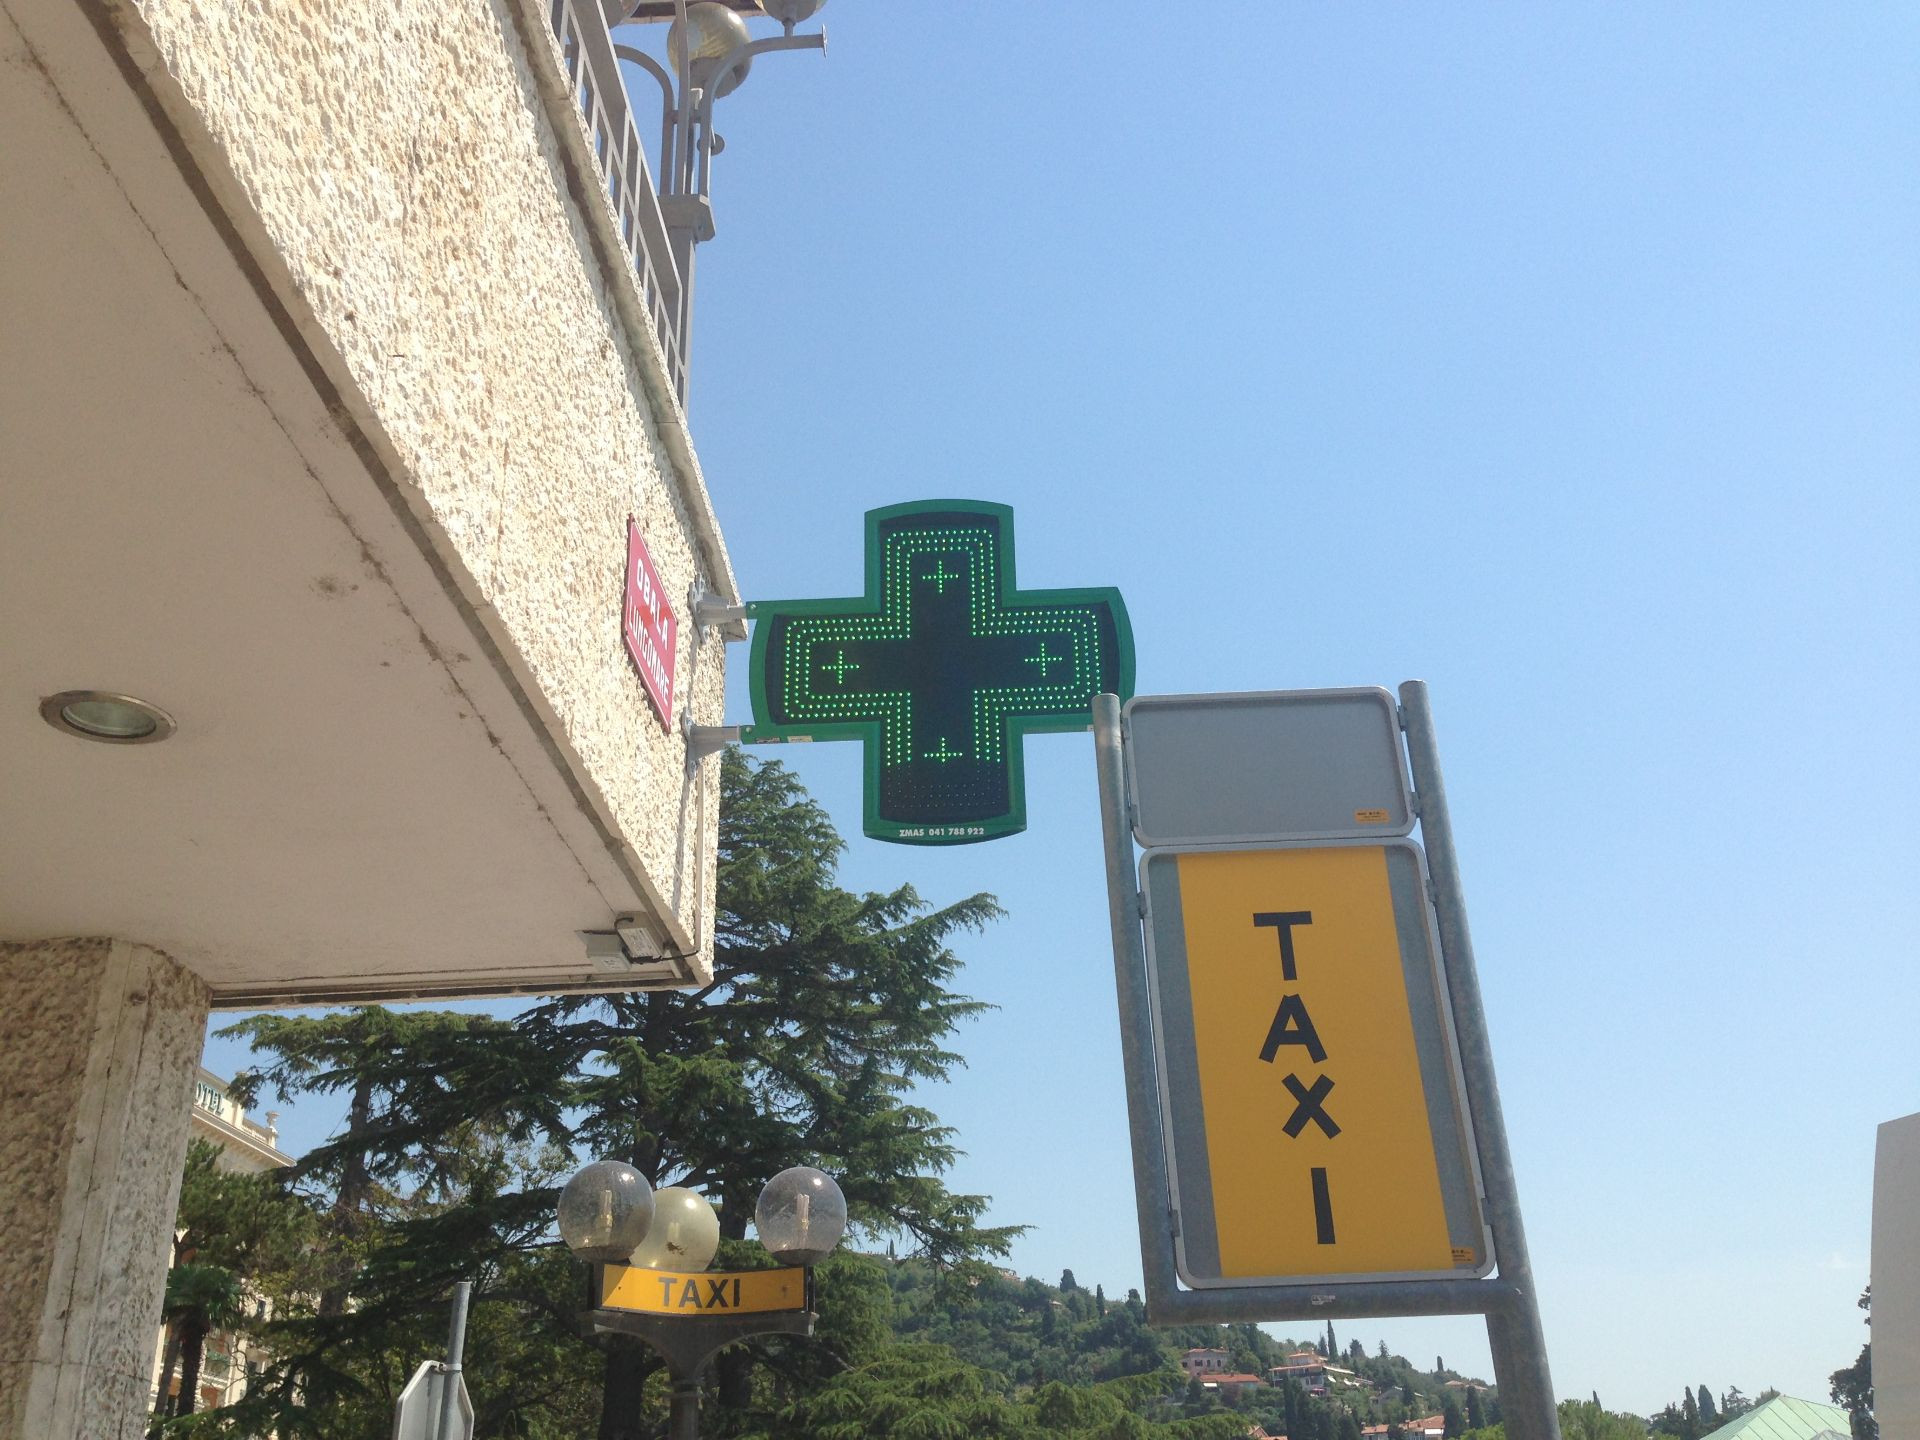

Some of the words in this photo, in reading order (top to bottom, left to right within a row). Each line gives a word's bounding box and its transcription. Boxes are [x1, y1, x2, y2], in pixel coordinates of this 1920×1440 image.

[636, 558, 669, 650] OBALA
[628, 595, 670, 706] LUNGOMARE
[899, 829, 925, 837] ZMAS
[928, 828, 945, 836] 041
[948, 828, 965, 836] 788
[967, 827, 985, 836] 922
[194, 1081, 225, 1115] OTEL
[1253, 911, 1342, 1244] TAXI
[658, 1276, 741, 1309] TAXI
